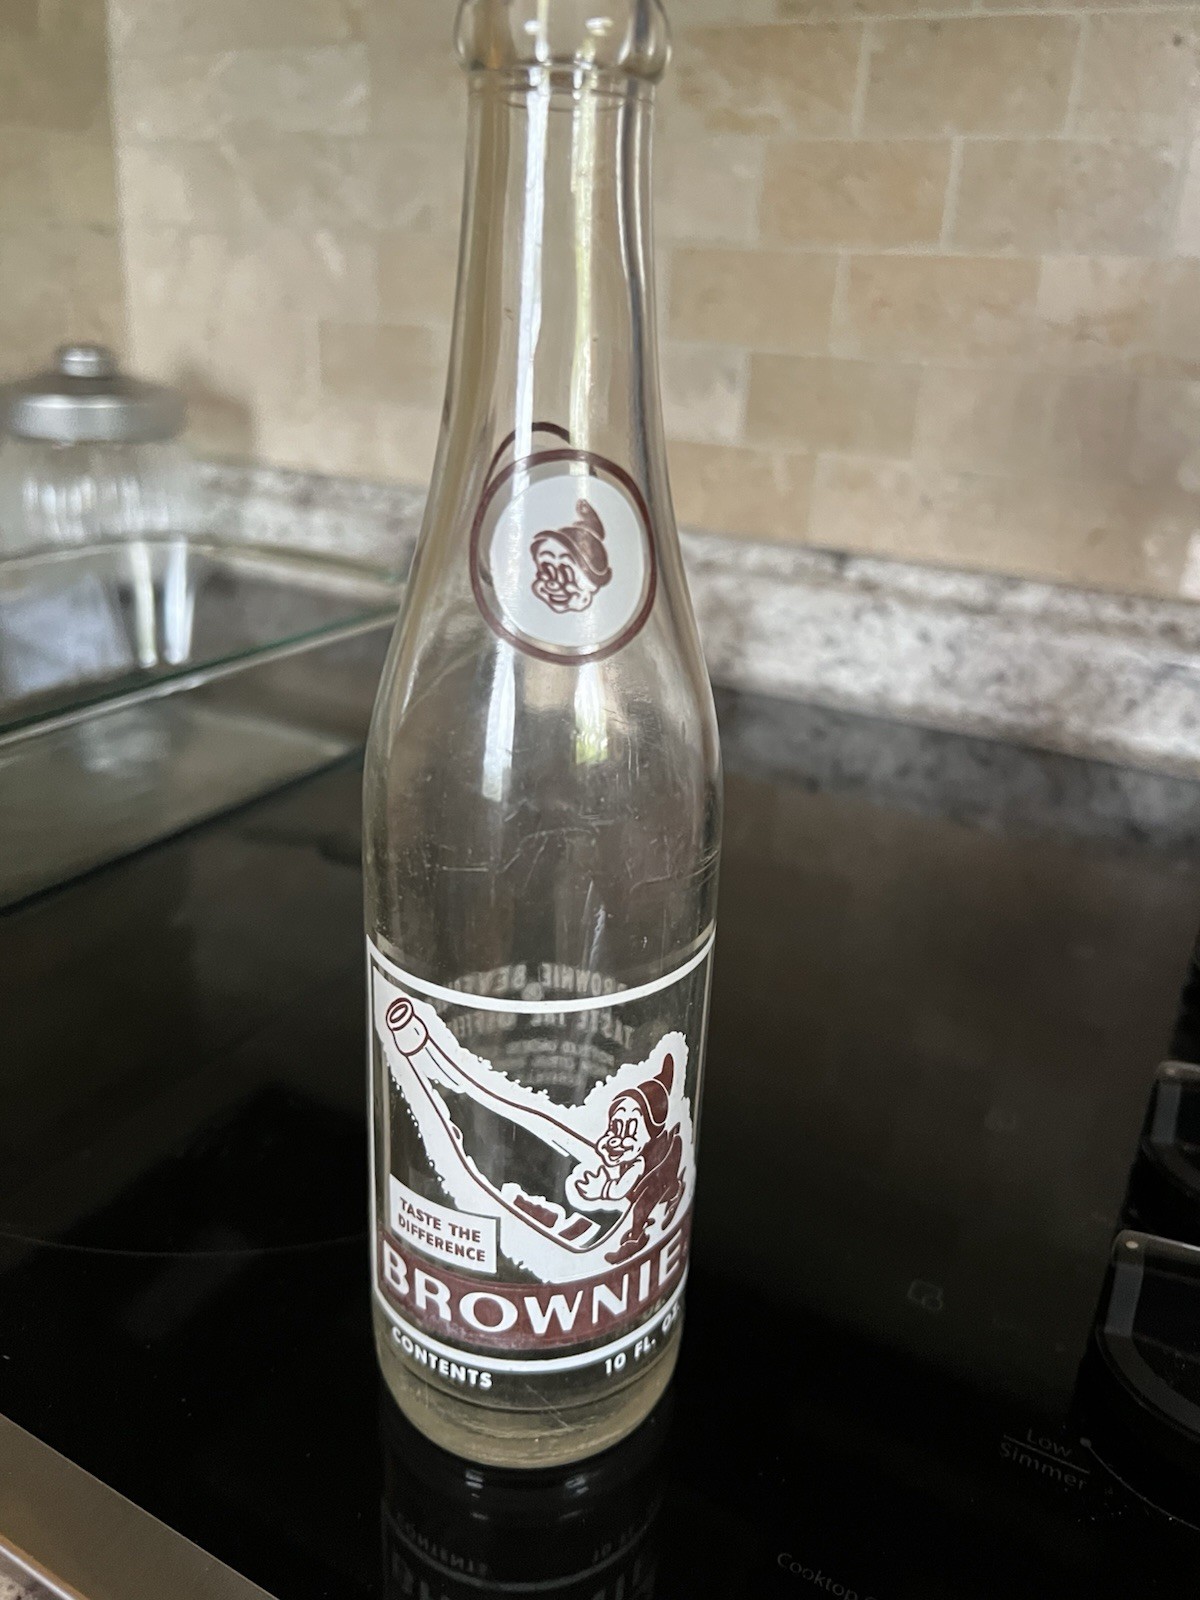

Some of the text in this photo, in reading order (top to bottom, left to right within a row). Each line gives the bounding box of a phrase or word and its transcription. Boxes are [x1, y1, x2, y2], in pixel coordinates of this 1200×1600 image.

[398, 1214, 486, 1263] DIFFERENCE
[400, 1197, 481, 1243] TASTE THE
[383, 1229, 682, 1335] BROWNIE
[391, 1326, 492, 1388] CONTENTS
[604, 1354, 626, 1376] 10
[634, 1339, 656, 1361] FL.
[1000, 1442, 1088, 1491] Simmer
[1026, 1428, 1071, 1458] Low
[777, 1552, 859, 1600] Cooktop
